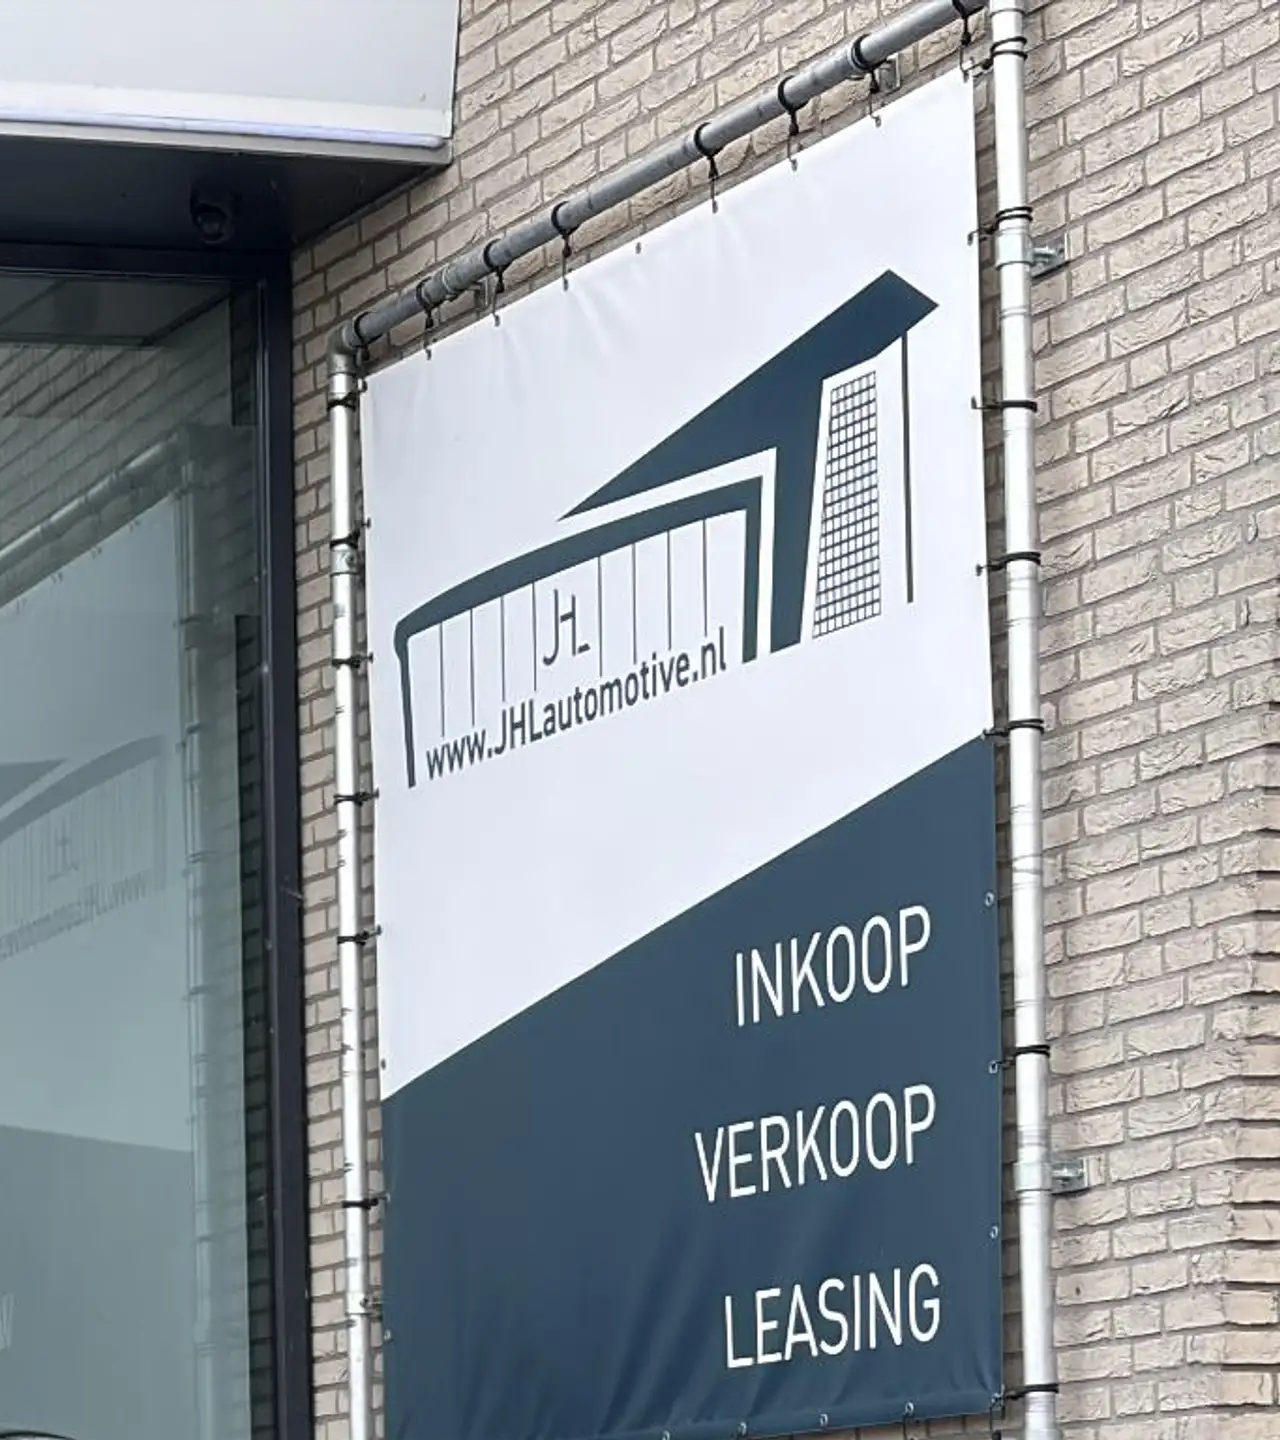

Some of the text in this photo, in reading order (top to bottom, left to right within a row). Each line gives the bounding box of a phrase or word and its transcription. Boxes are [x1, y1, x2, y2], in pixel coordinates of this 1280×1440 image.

[426, 627, 727, 779] www.JHLautomotive.nl
[736, 905, 931, 1027] INKOOP
[695, 1084, 936, 1202] VERKOOP
[725, 1263, 940, 1369] LEASING
